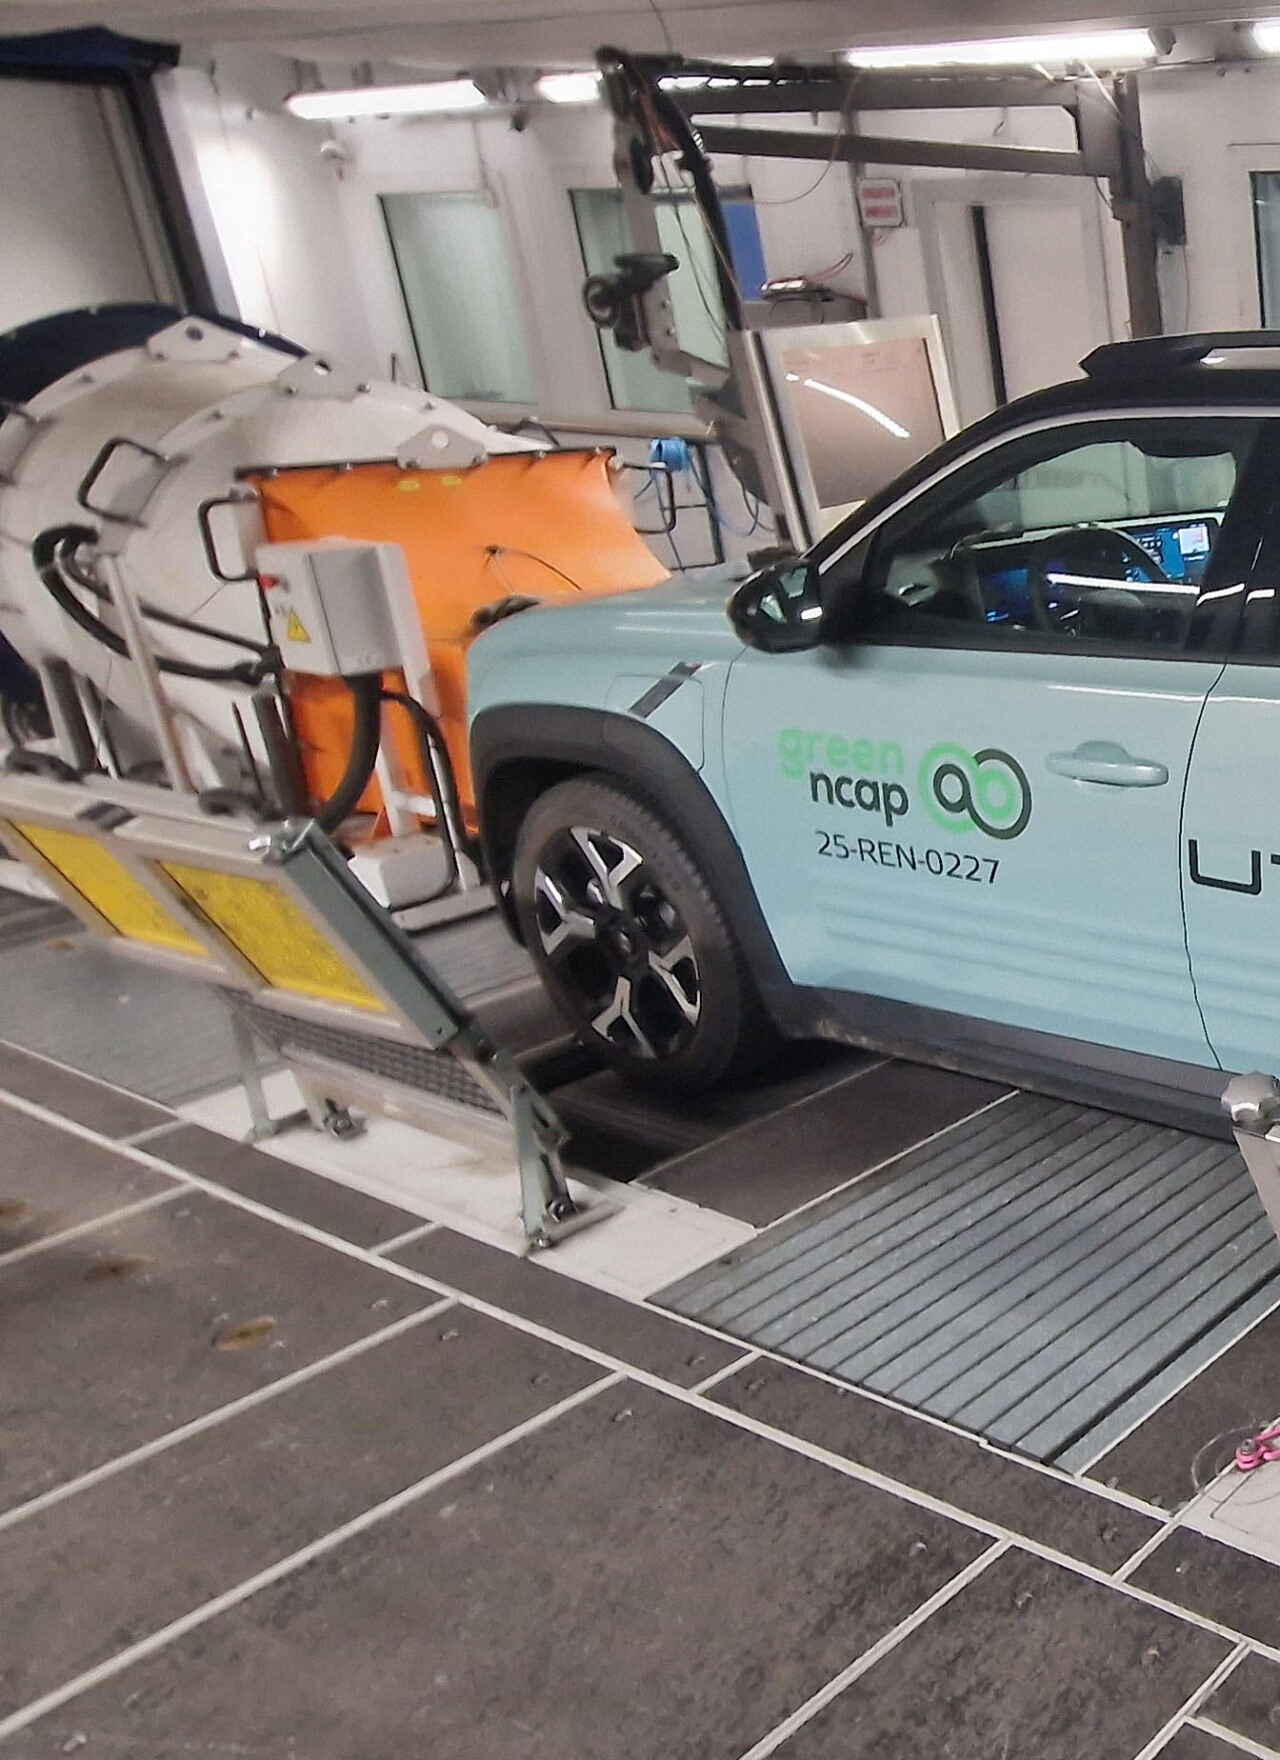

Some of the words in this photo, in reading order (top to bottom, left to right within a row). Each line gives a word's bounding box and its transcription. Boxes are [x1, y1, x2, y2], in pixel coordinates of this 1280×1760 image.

[779, 729, 904, 779] green
[809, 771, 909, 827] ncap
[815, 831, 1000, 883] 25-REN-0227
